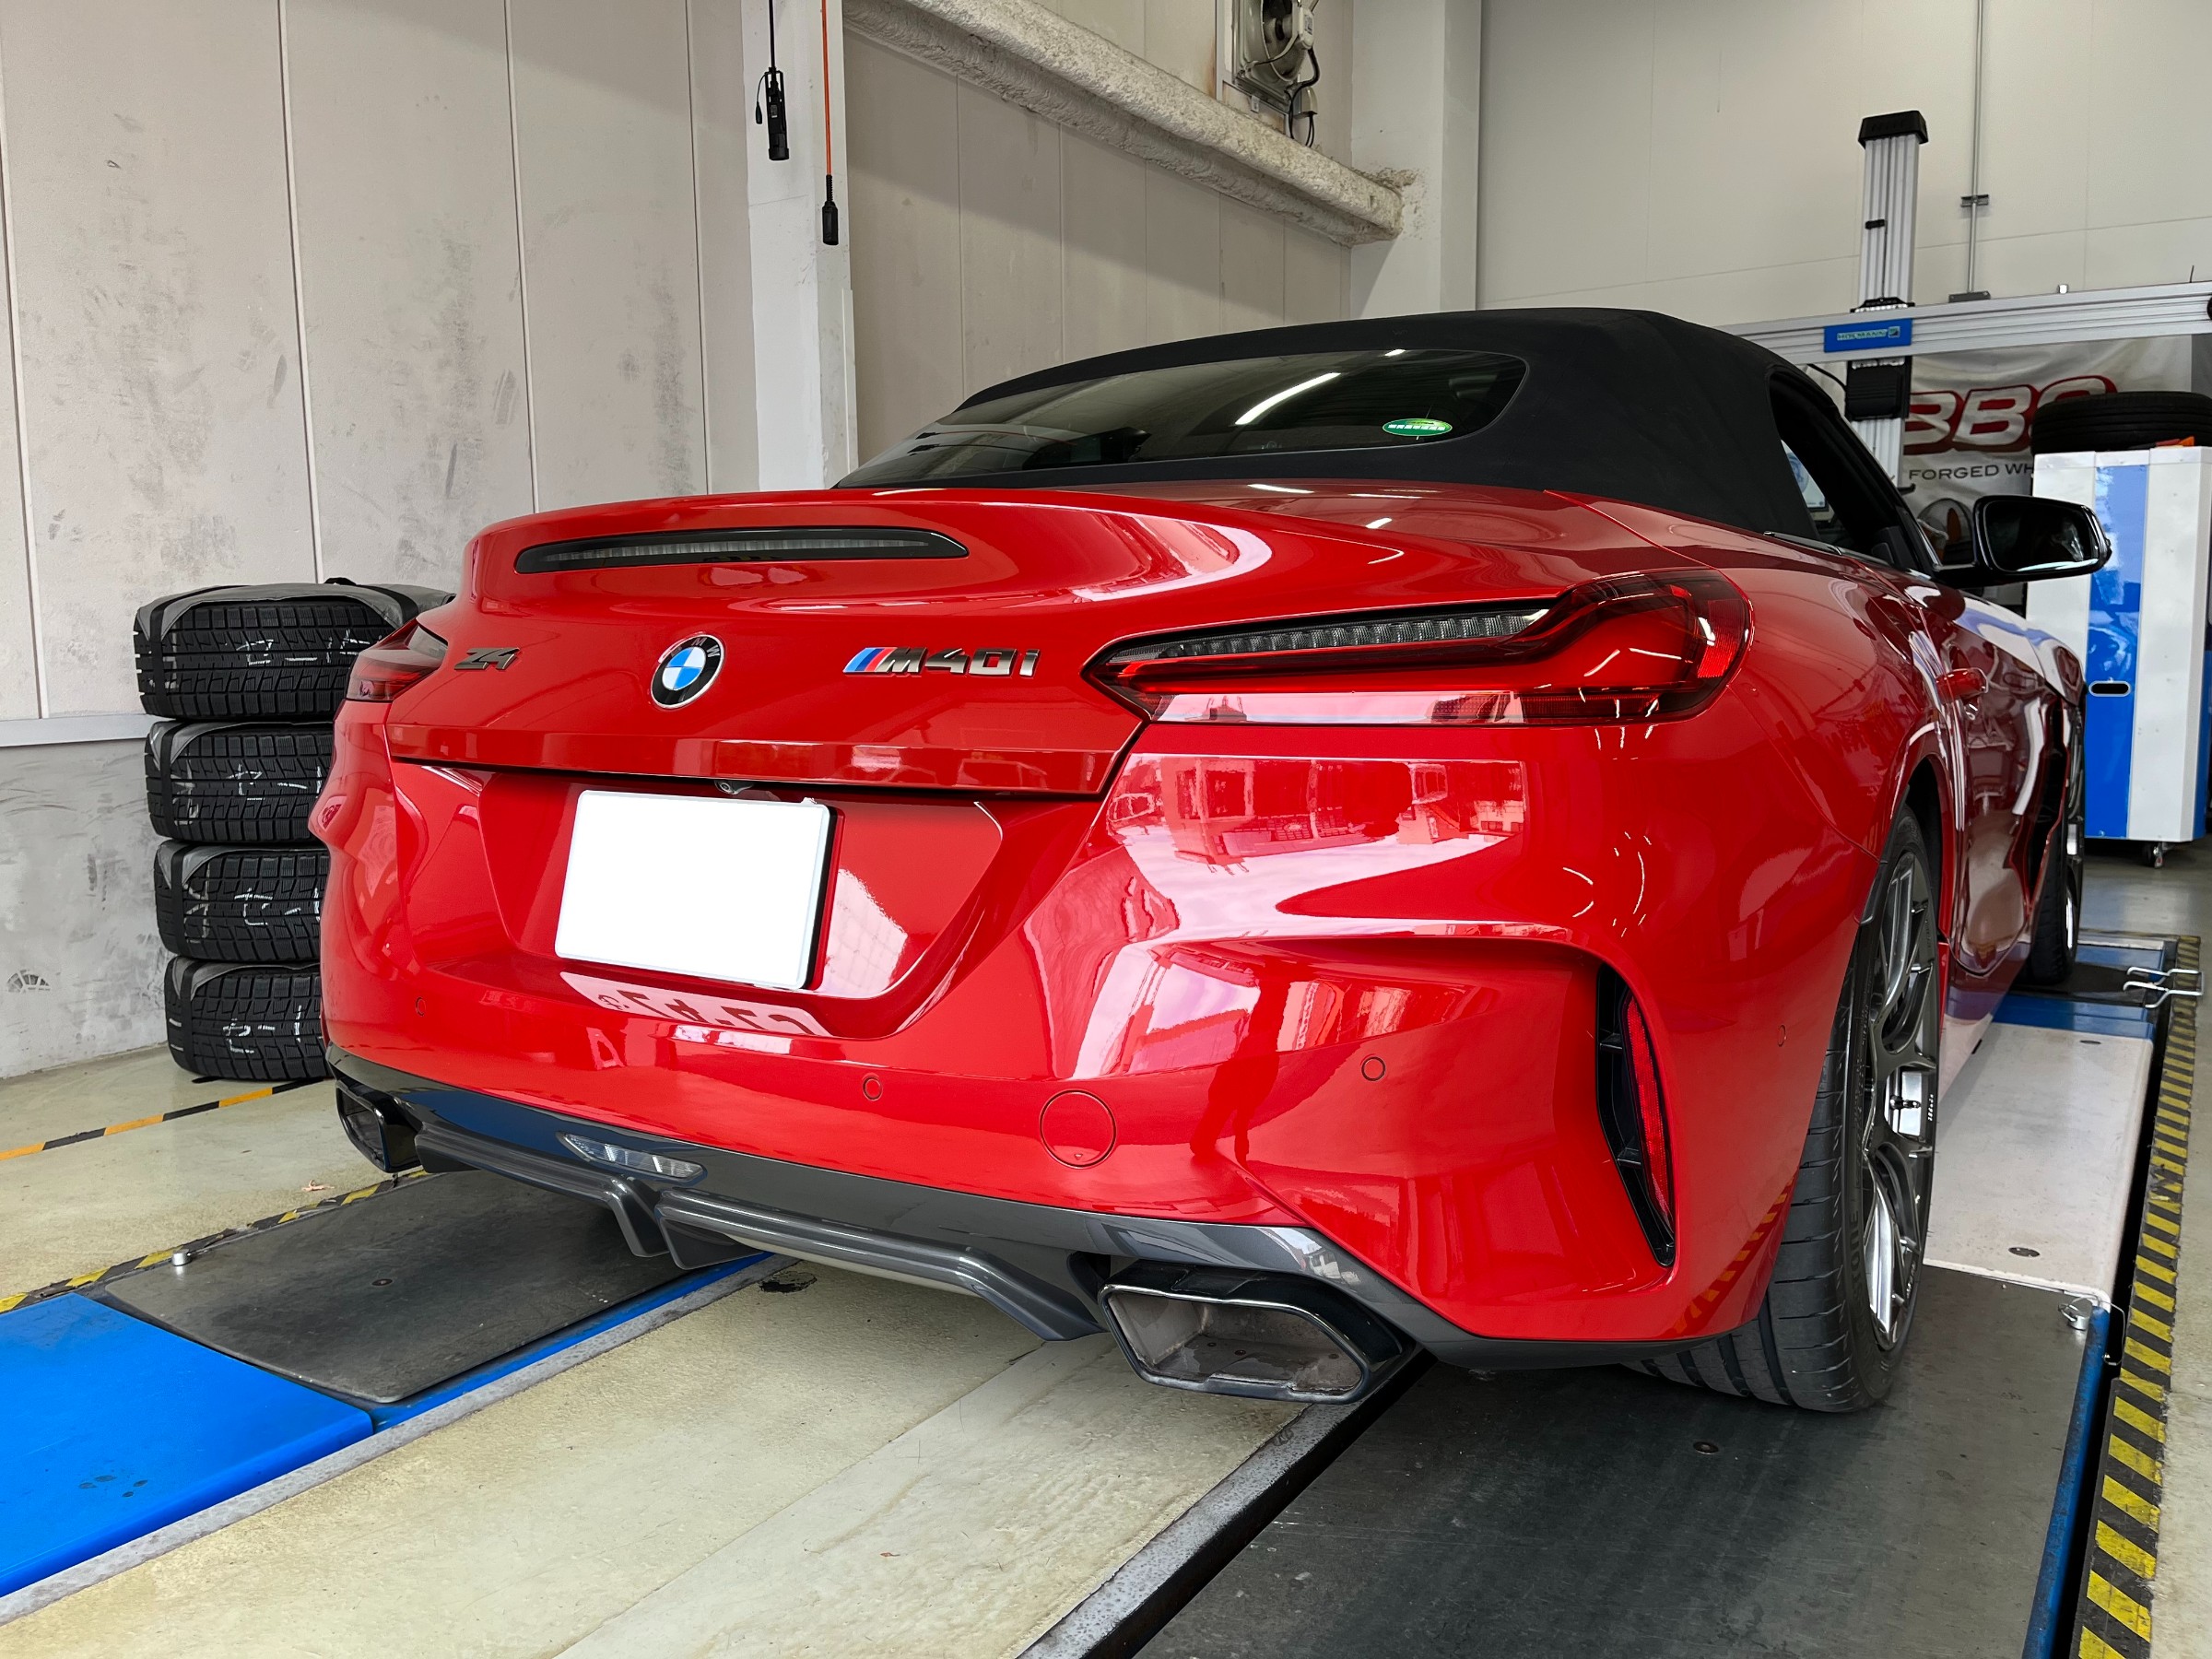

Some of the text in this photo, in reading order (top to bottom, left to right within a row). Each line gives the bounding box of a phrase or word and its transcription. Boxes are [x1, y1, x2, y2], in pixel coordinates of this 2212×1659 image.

[1903, 375, 2118, 455] BB
[1909, 465, 1999, 480] FORGED
[454, 647, 520, 670] Z4
[843, 647, 1040, 677] M40i
